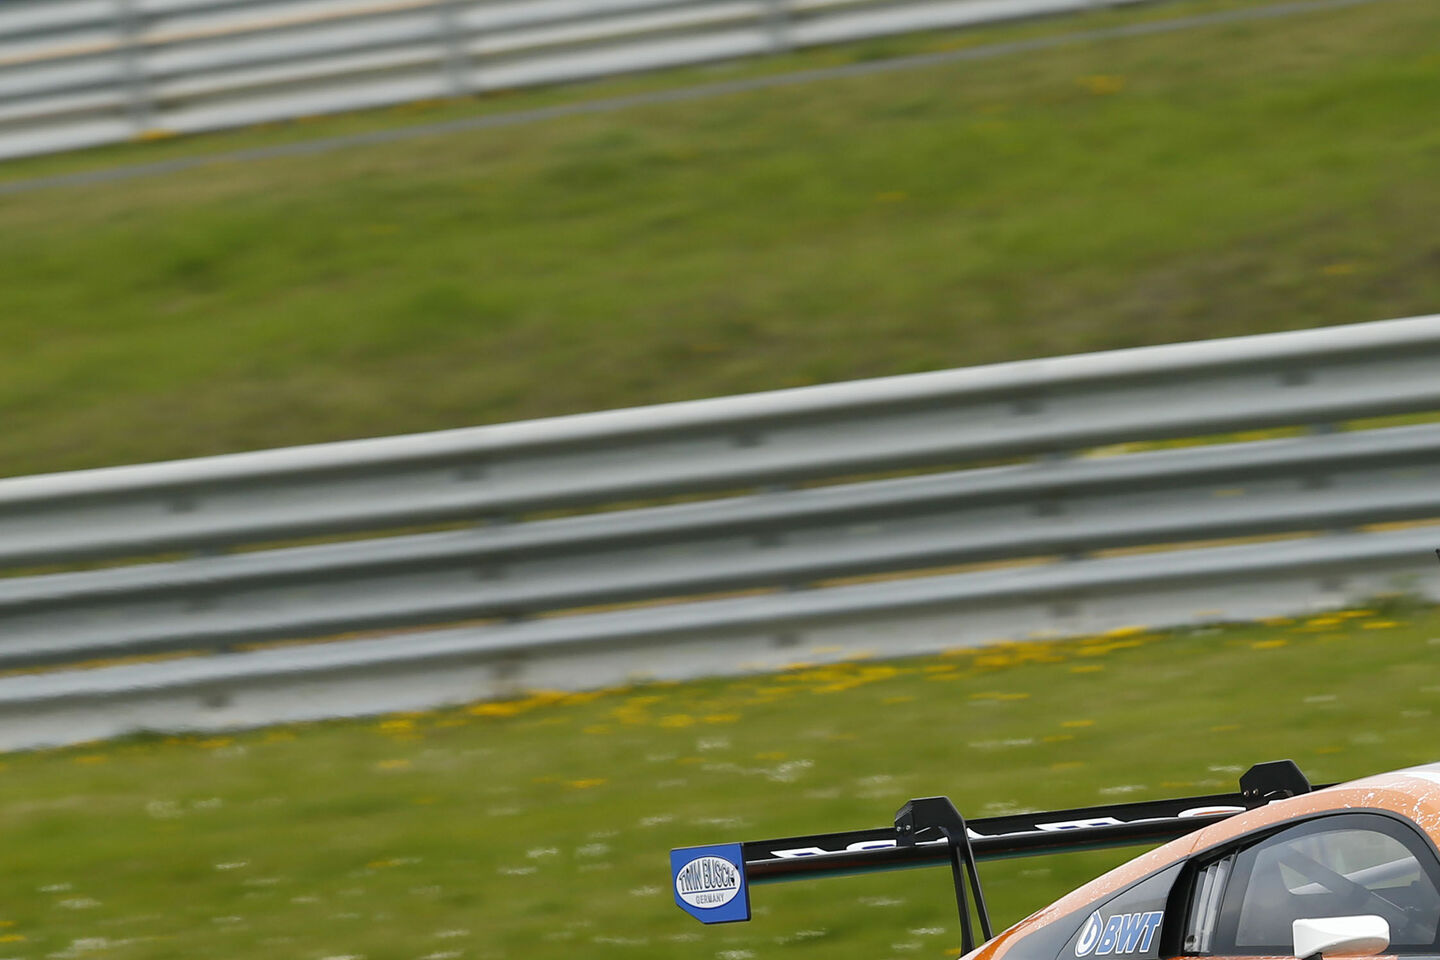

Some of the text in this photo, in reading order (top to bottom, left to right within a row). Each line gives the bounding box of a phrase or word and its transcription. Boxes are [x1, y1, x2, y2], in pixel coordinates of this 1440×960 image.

[679, 859, 736, 892] TWIN BUSCH
[695, 894, 725, 905] GERMANY
[1095, 910, 1164, 955] BWT
